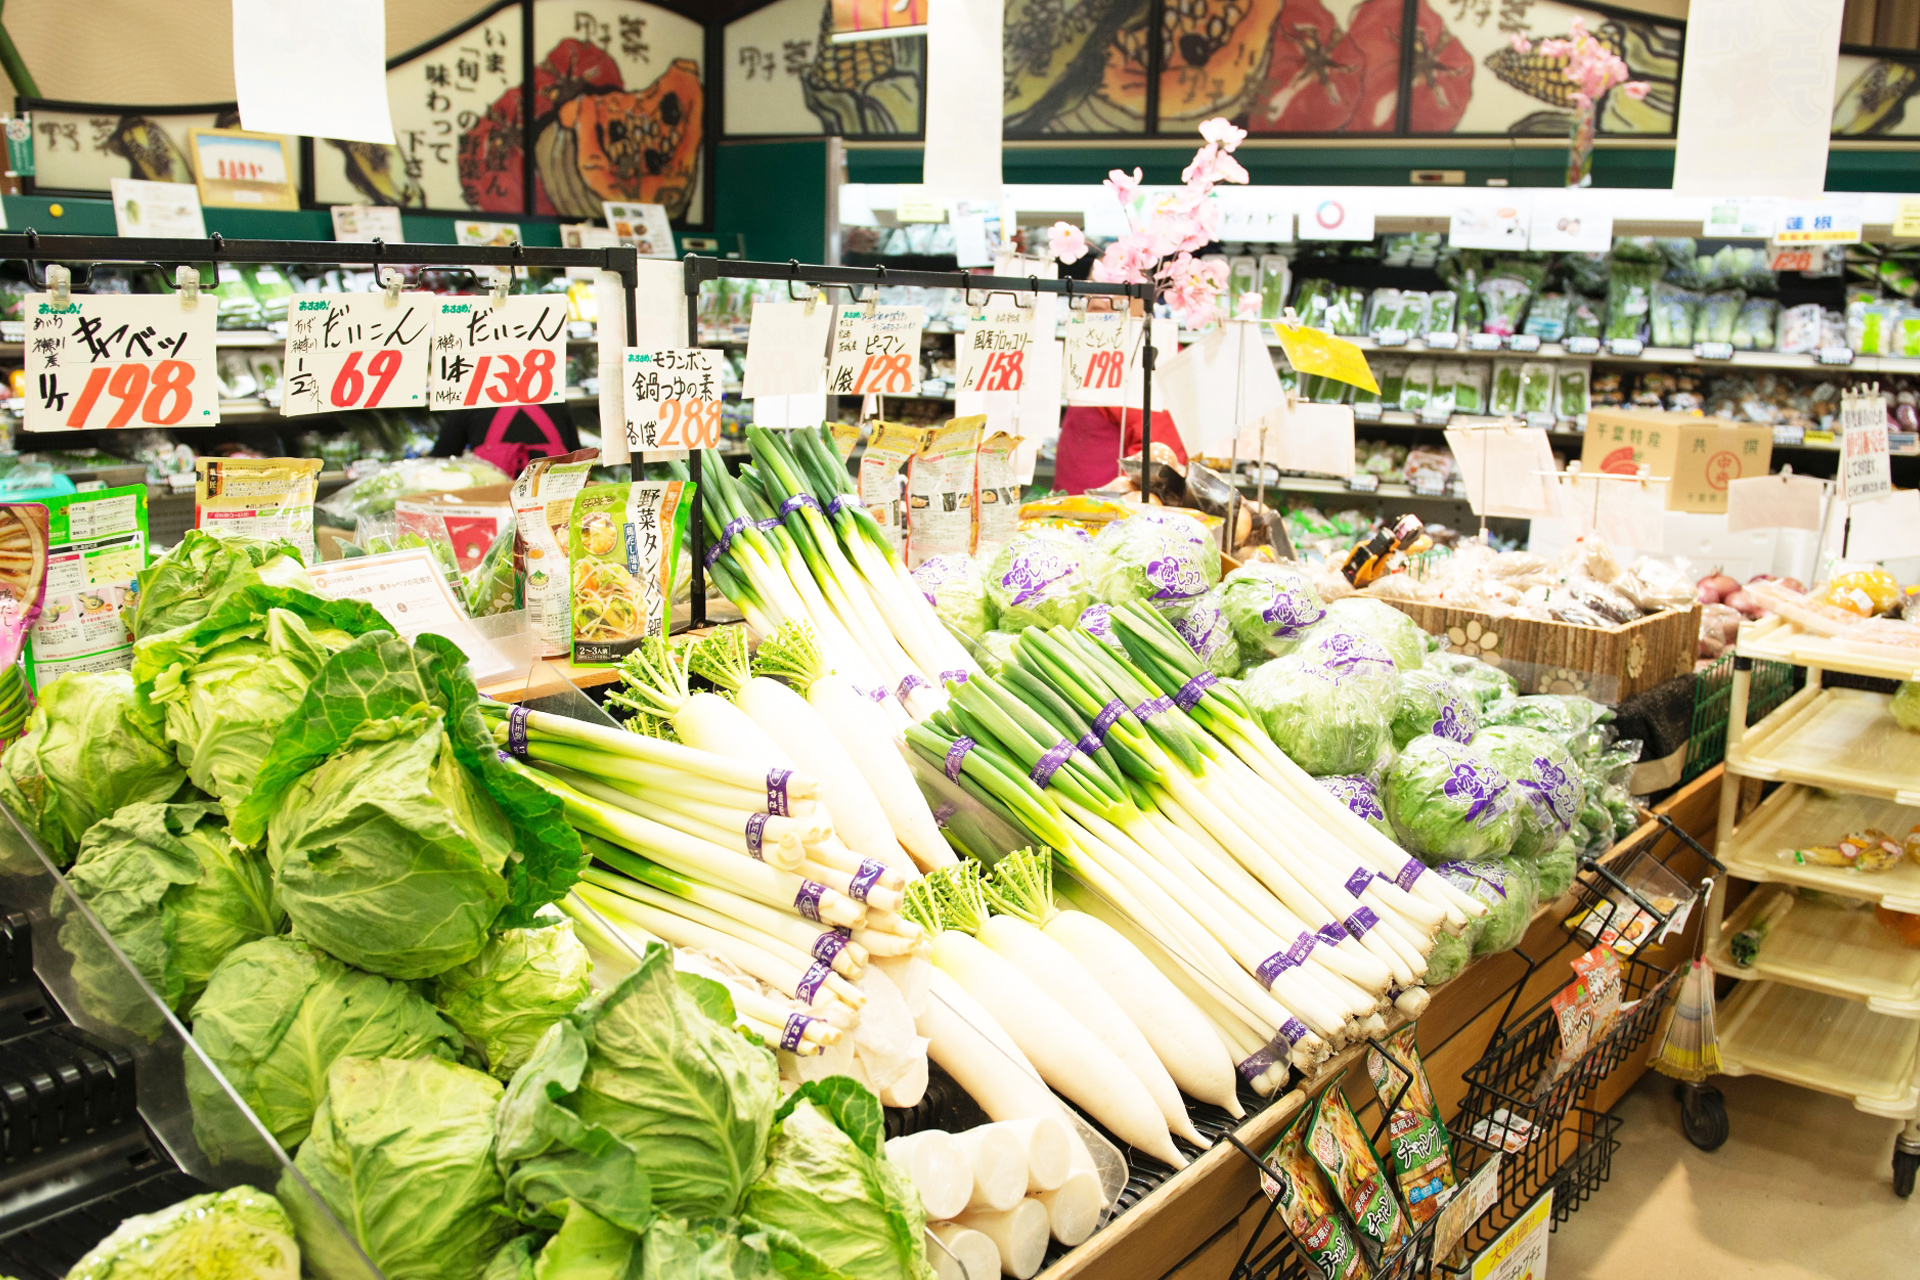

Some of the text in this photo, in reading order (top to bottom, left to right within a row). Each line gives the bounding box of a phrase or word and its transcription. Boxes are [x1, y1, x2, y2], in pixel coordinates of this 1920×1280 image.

[425, 63, 452, 164] 味わって
[72, 317, 188, 362] キャベツ
[323, 305, 429, 348] だいこん
[466, 307, 567, 347] だいこん
[865, 335, 906, 356] ピーマン
[330, 350, 402, 408] 69
[441, 354, 475, 383] 1本
[463, 349, 557, 407] 138
[653, 350, 712, 370] モランボン
[851, 354, 913, 396] 128
[974, 350, 1025, 391] 158
[1082, 351, 1125, 389] 198
[66, 360, 196, 429] 198
[631, 371, 714, 402] 鍋つゆの素
[657, 398, 722, 449] 288
[636, 488, 662, 638] 野菜タンメン鍋
